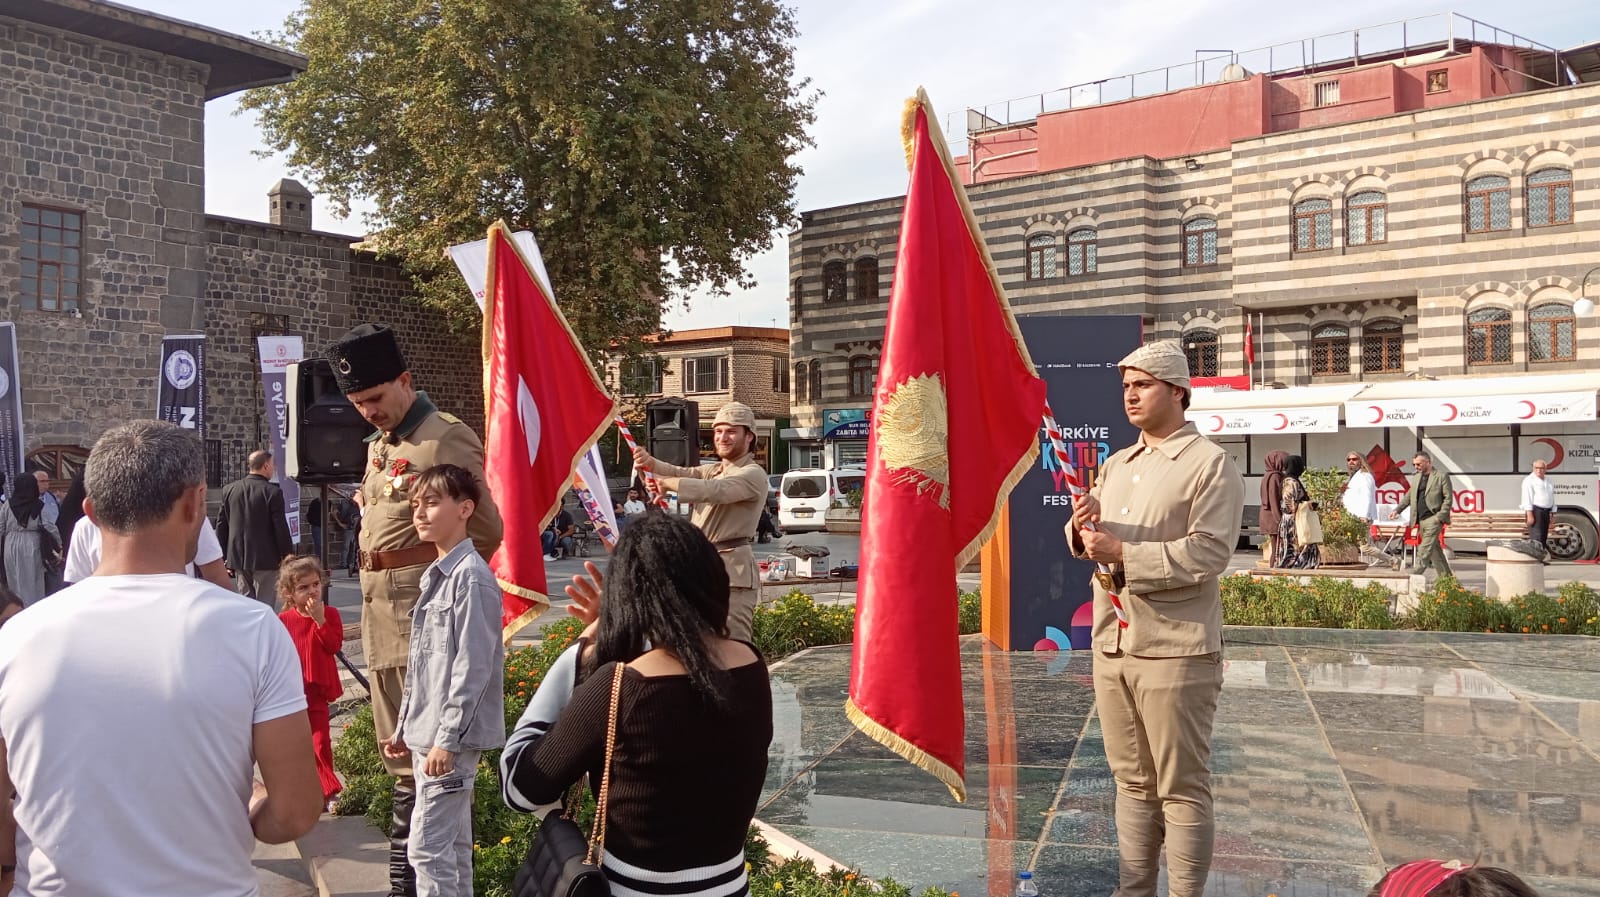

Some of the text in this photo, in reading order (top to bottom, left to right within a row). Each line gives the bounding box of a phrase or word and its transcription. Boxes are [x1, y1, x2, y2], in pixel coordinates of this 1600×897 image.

[1386, 412, 1416, 420] KIZILAY
[1051, 466, 1103, 492] YL
[1450, 490, 1485, 513] ACI
